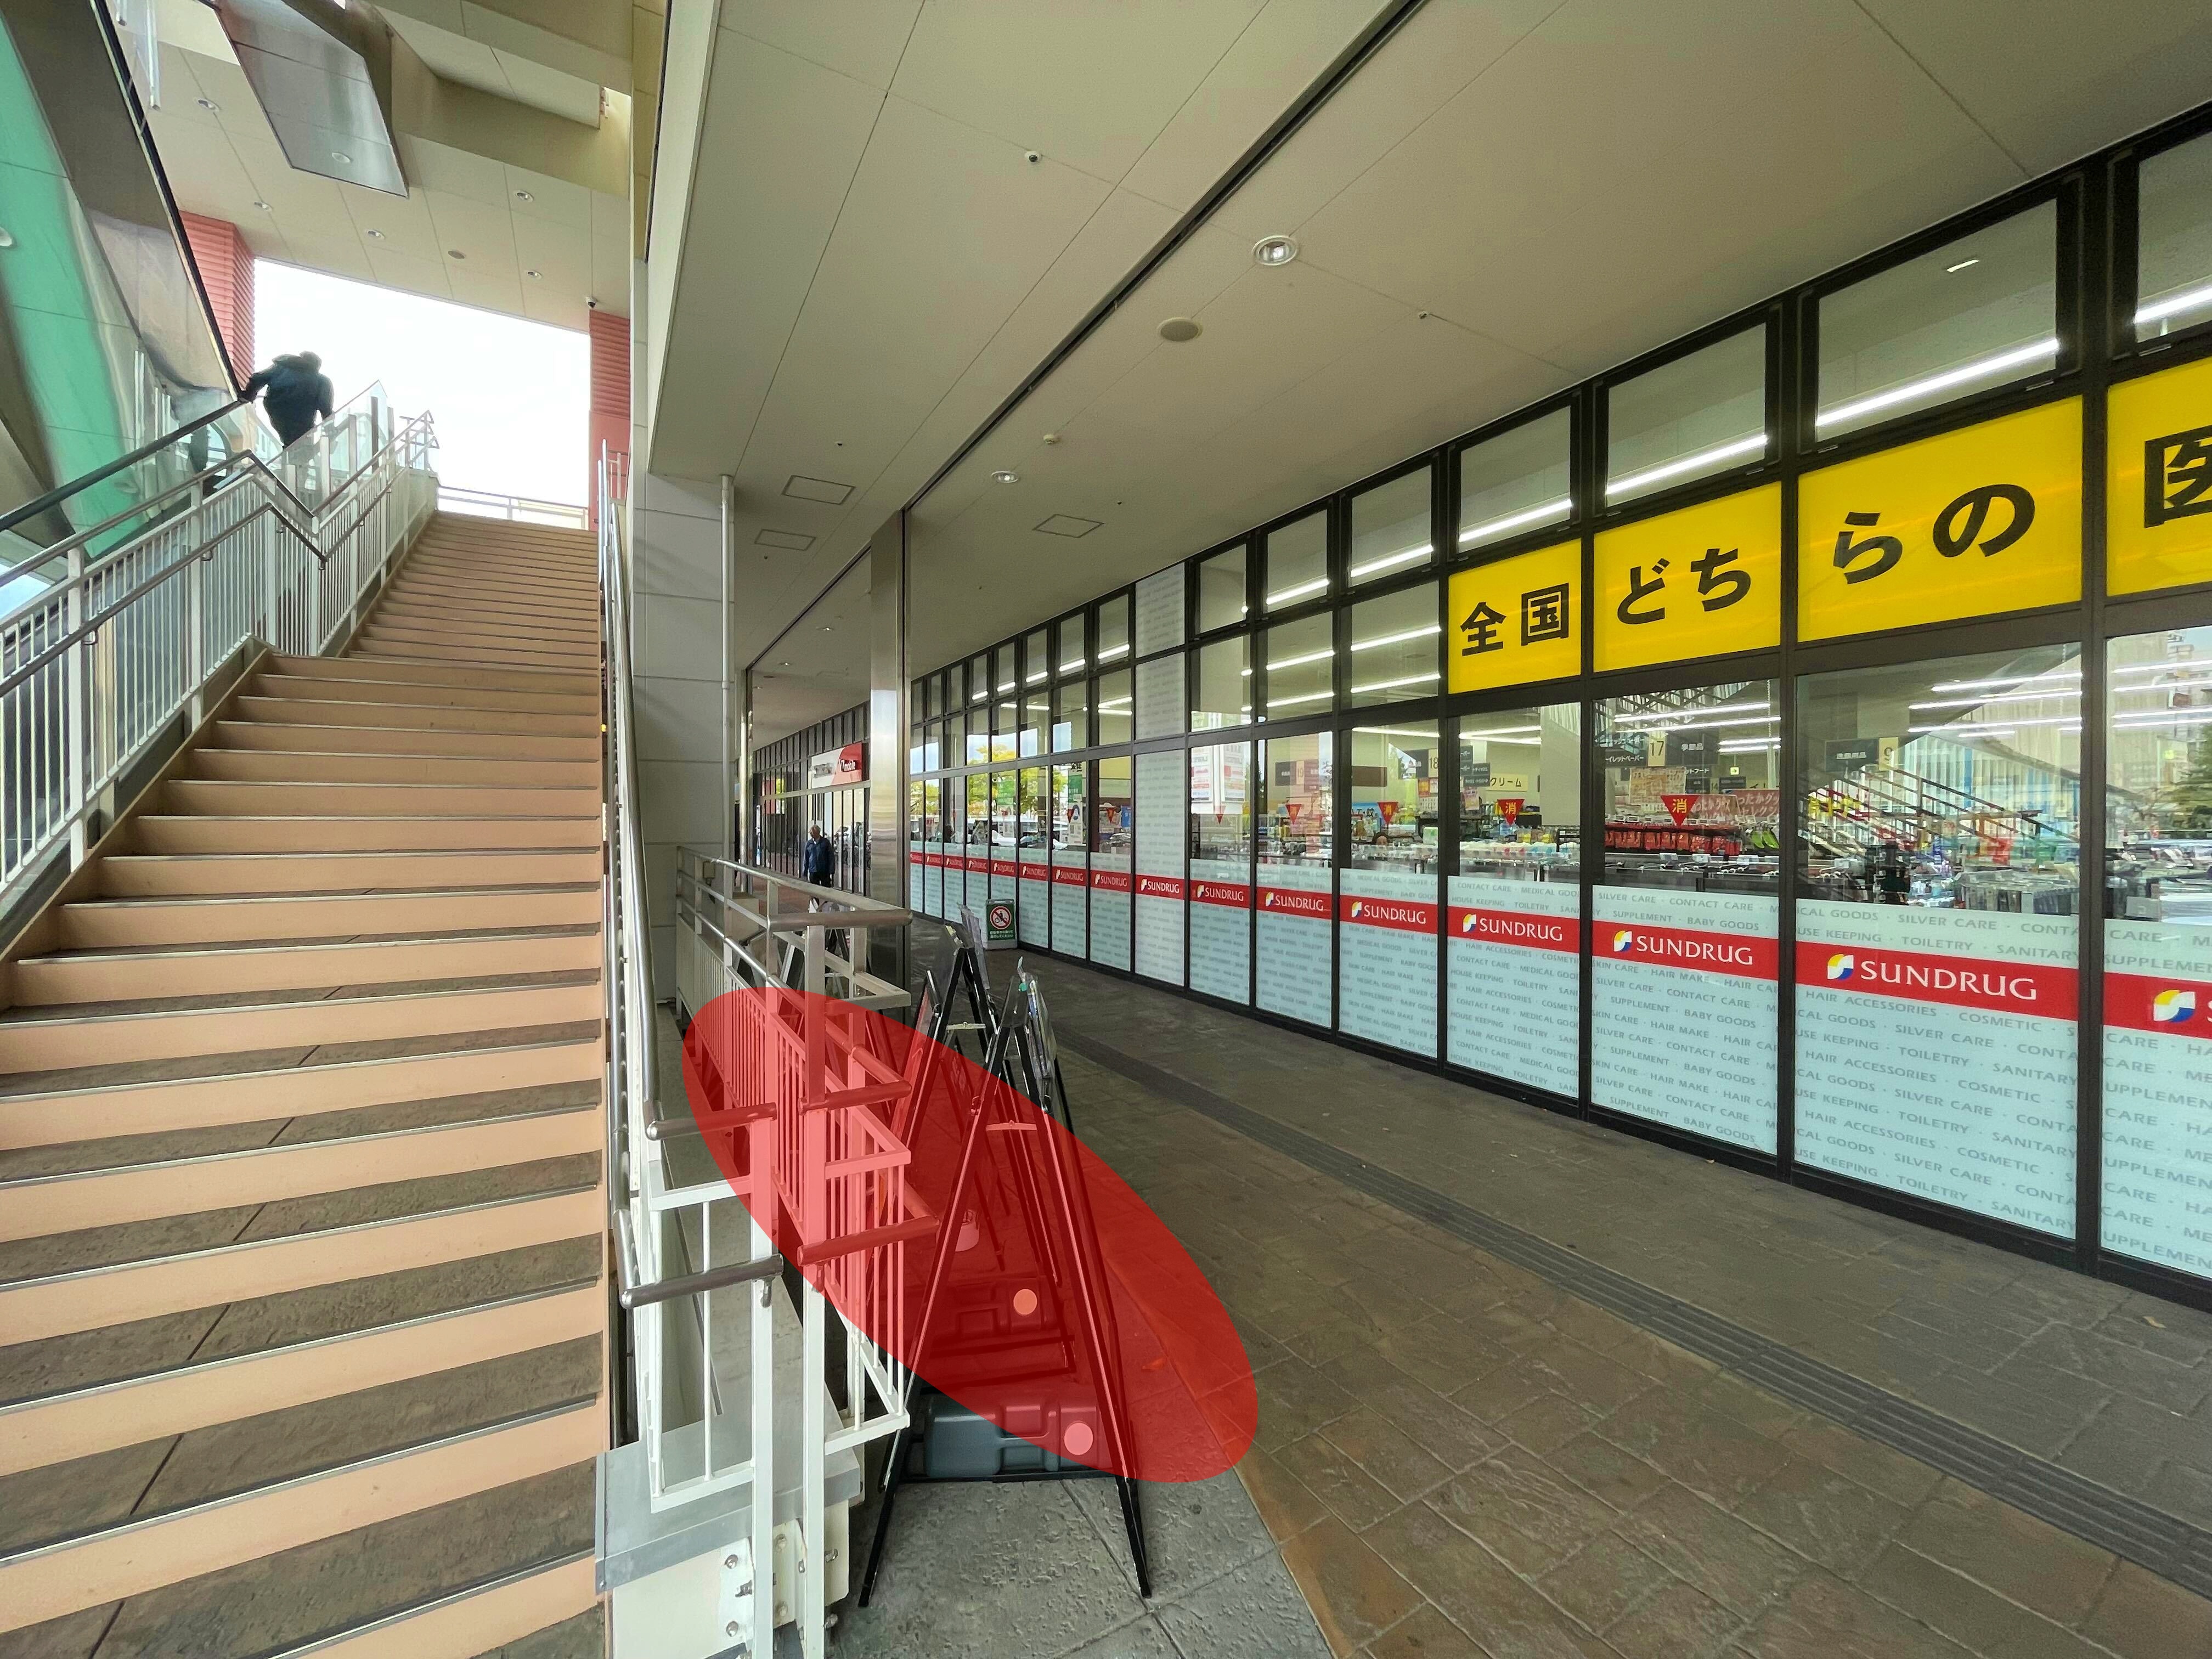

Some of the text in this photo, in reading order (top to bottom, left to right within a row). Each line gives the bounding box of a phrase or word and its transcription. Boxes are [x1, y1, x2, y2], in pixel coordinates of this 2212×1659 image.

[1605, 755, 1645, 763] イレットペーパー
[1650, 741, 1664, 756] 17
[1429, 757, 1438, 769] 18
[1490, 777, 1522, 787] クリーム
[1505, 802, 1516, 815] 消
[1672, 799, 1688, 814] 消
[1060, 871, 1084, 882] SUNDRUG
[1101, 876, 1127, 887] SUNDRUG
[1148, 881, 1180, 893] SUNDRUG
[1205, 887, 1244, 901] SUNDRUG
[1276, 895, 1323, 911] SUNDRUG
[1599, 893, 1753, 911] SILVER CARE CONTACT CARE
[1364, 905, 1426, 924] SUNDRUG
[1613, 910, 1759, 930] SUPPLEMENT BABY GOODS
[1831, 909, 1878, 921] GOODS
[1898, 914, 1947, 926] SILVER
[1955, 918, 1997, 930] CARE
[1480, 918, 1563, 941] SUNDRUG
[1826, 930, 1882, 942] KEEPING
[1902, 936, 1973, 950] TOILETRY
[1636, 935, 1753, 966] SUNDRUG
[1615, 964, 1639, 973] CARE
[1651, 969, 1675, 978] HAIR
[1724, 979, 1751, 990] HAIR
[1860, 961, 2036, 1000] SUNDRUG
[1596, 977, 1750, 1008] SILVER CARE CONTACT CARE
[1611, 996, 1756, 1028] SUPPLEMENT BABY GOODS
[1806, 991, 2042, 1032] HAIR ACCESSORIES COSMETIC
[1615, 1014, 1639, 1025] CARE
[1651, 1021, 1674, 1031] HAIR
[1679, 1026, 1709, 1039] MAKE
[1724, 1035, 1751, 1046] HAIR
[1829, 1014, 1876, 1029] GOODS
[1895, 1024, 1943, 1040] SILVER
[1951, 1033, 1994, 1048] CARE
[2106, 1033, 2159, 1049] CARE
[1596, 1026, 1750, 1065] SILVER CARE CONTACT CARE
[1824, 1034, 1879, 1051] KEEPING
[1899, 1047, 1970, 1068] TOILETRY
[1610, 1046, 1756, 1086] SUPPLEMENT BABY GOODS
[1806, 1050, 2041, 1103] HAIR ACCESSORIES COSMETIC
[1614, 1065, 1638, 1076] CARE
[1650, 1073, 1674, 1085] HAIR
[1679, 1080, 1709, 1093] MAKE
[1723, 1091, 1751, 1104] HAIR
[1827, 1075, 1875, 1092] GOODS
[1894, 1088, 1944, 1107] SILVER
[1950, 1101, 1993, 1116] CARE
[1596, 1076, 1750, 1122] SILVER CARE CONTACT CARE
[1610, 1096, 1756, 1143] SUPPLEMENT BABY GOODS
[1823, 1094, 1878, 1114] KEEPING
[1899, 1111, 1969, 1134] TOILETRY
[2106, 1108, 2158, 1125] CARE
[1805, 1110, 2040, 1174] HAIR ACCESSORIES COSMETIC
[1827, 1136, 1875, 1155] GOODS
[1894, 1153, 1943, 1172] SILVER
[1950, 1168, 1992, 1186] CARE
[1822, 1155, 1878, 1177] KEEPING
[1897, 1176, 1968, 1201] TOILETRY
[2104, 1182, 2157, 1203] CARE
